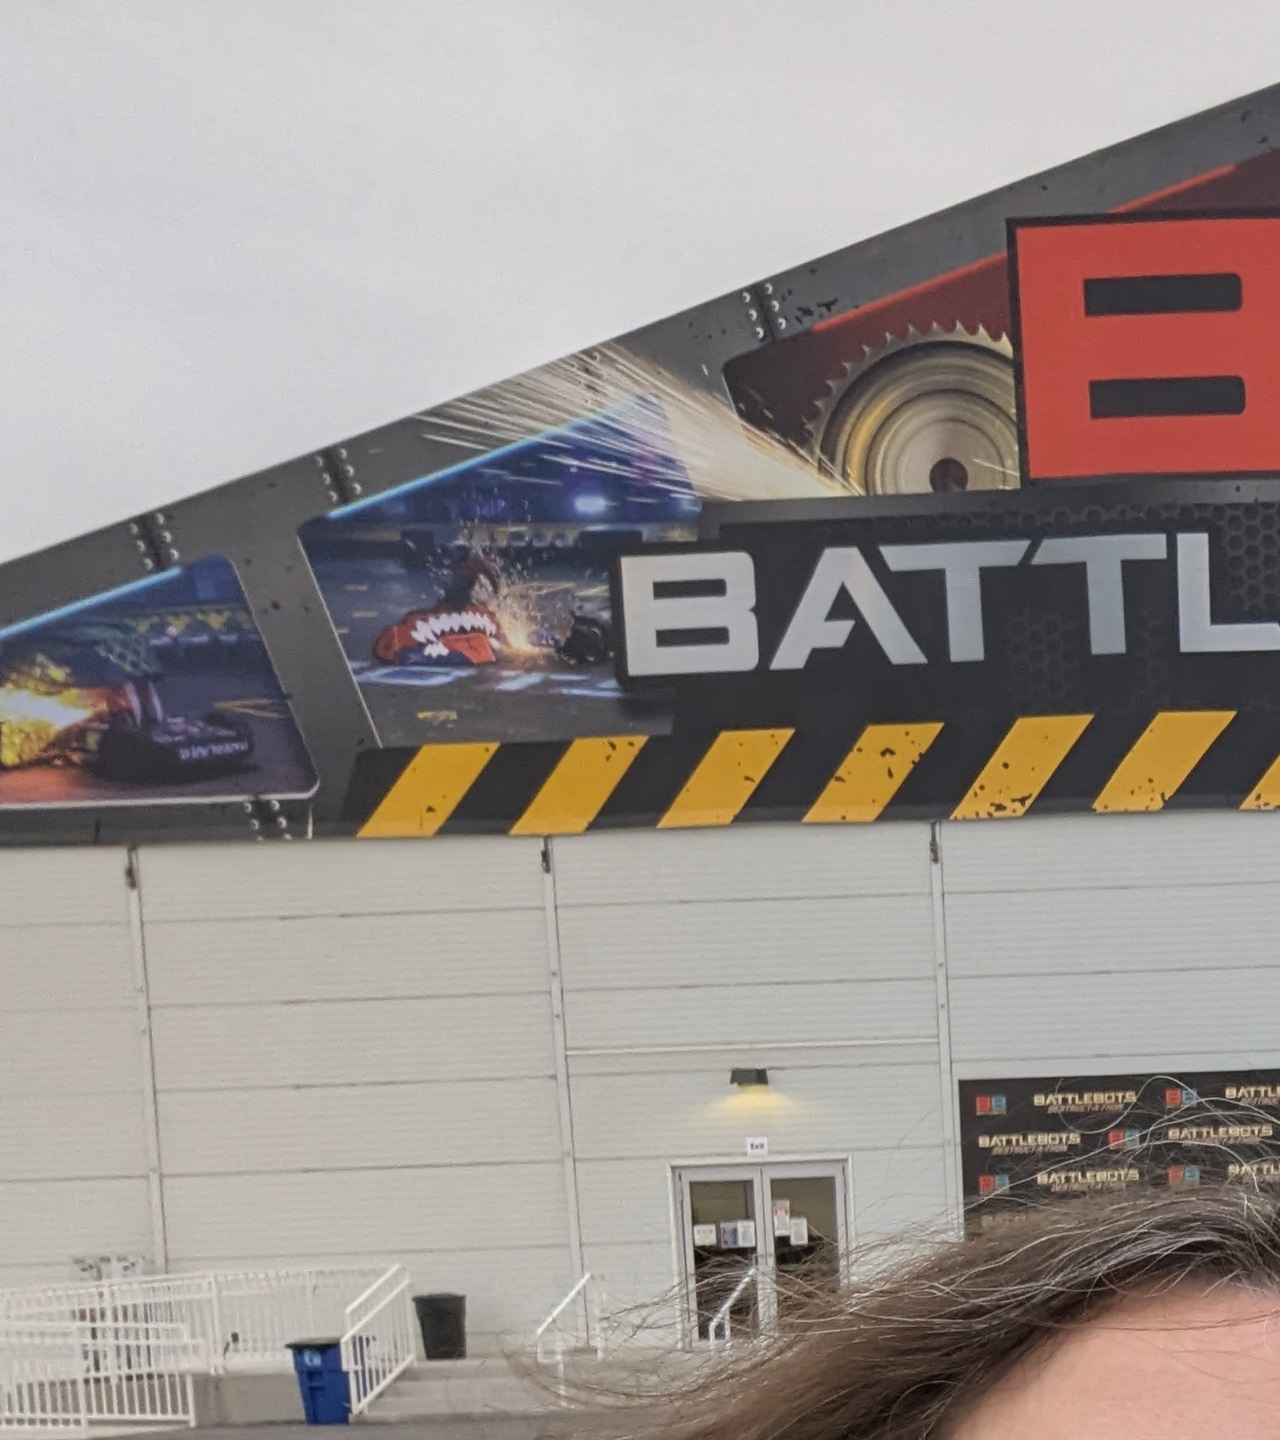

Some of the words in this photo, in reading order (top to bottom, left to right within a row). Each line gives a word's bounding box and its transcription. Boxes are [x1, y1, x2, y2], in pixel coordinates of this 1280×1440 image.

[1034, 1091, 1137, 1106] BATTLEBOTS
[1168, 1124, 1273, 1139] BATTLEBOTS
[978, 1133, 1080, 1148] BATTLEBOTS
